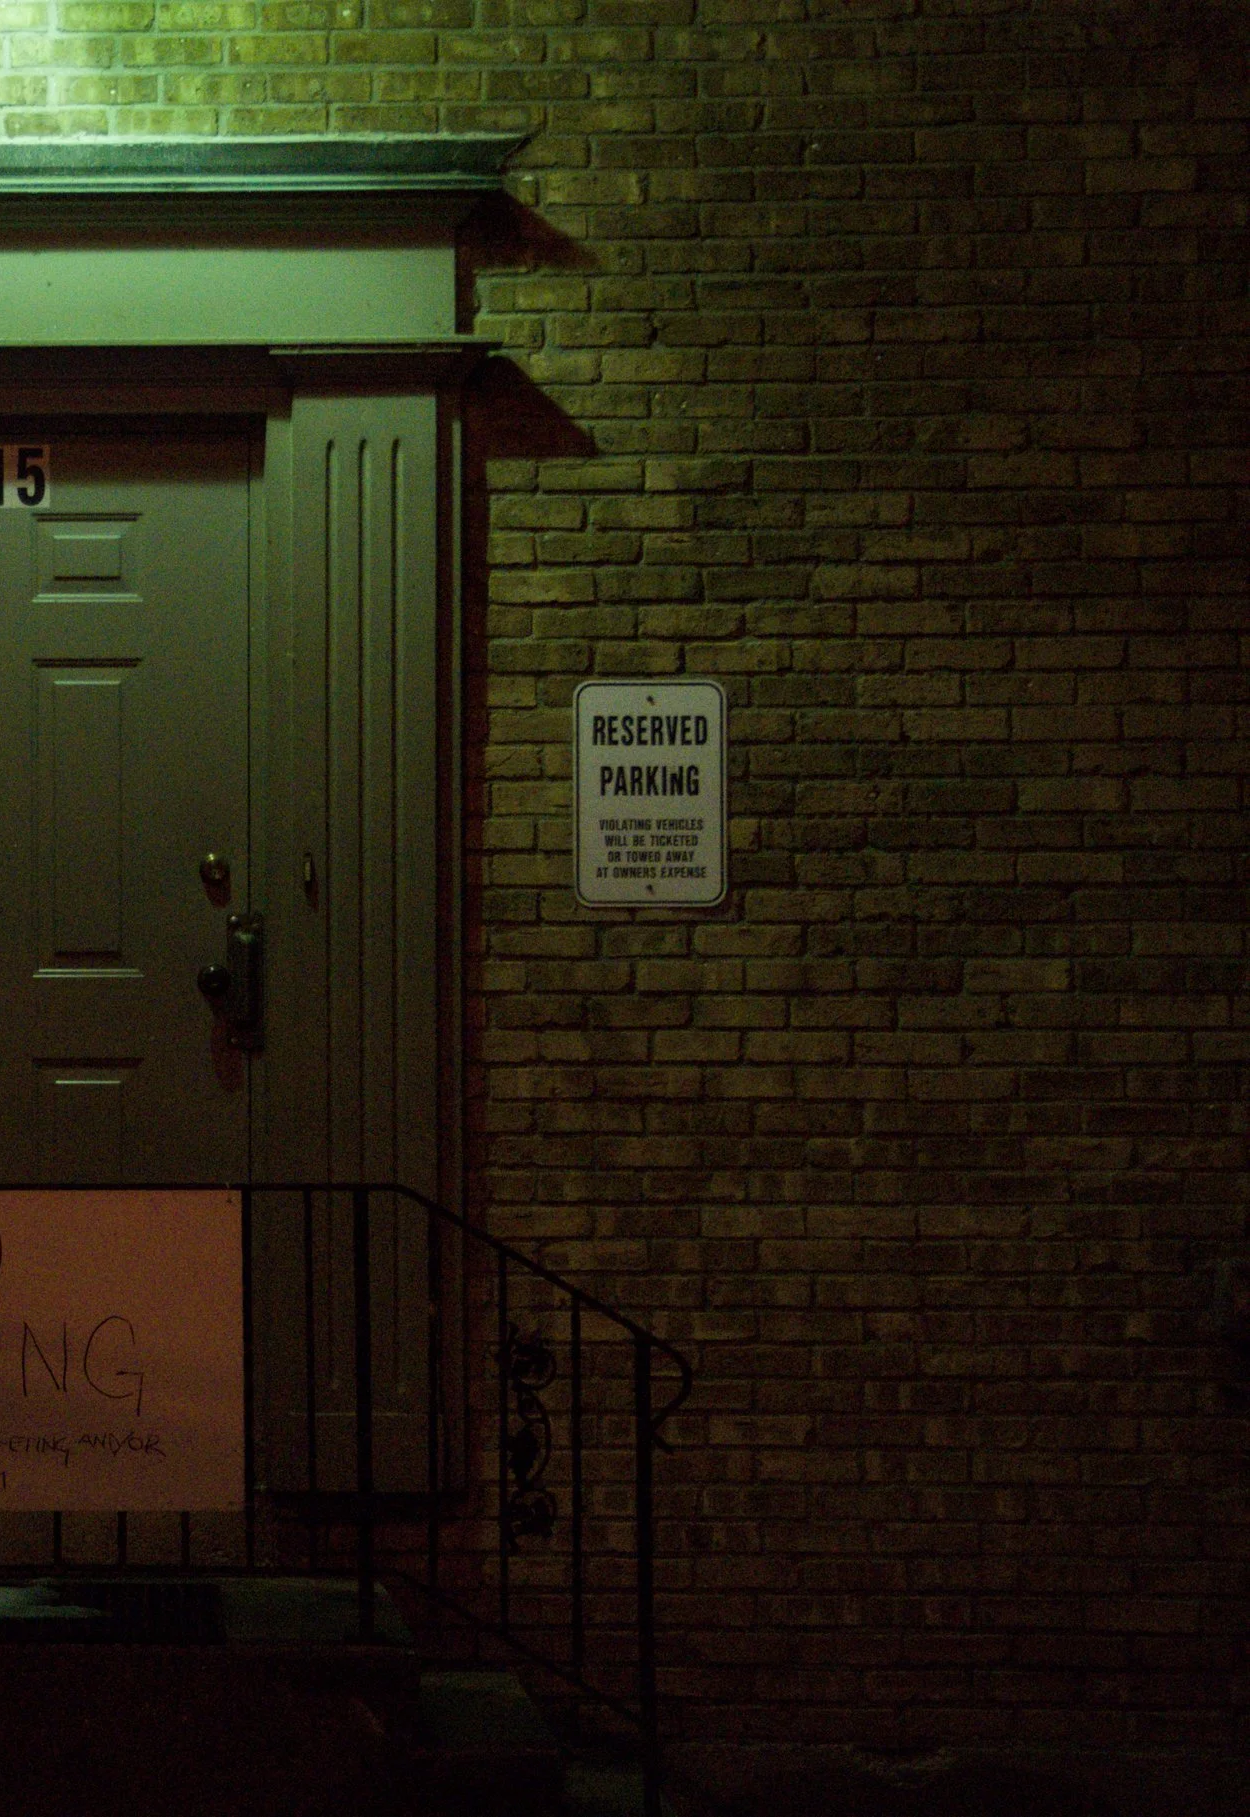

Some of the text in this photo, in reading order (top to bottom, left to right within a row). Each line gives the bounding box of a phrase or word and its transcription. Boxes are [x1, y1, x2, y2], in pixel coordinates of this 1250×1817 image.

[592, 715, 708, 746] RESERVED
[600, 766, 700, 796] PARKING
[599, 819, 704, 831] VIOLATING VEHICLES
[604, 835, 699, 847] WILL BE TICKETED
[608, 851, 694, 863] OR TOWED AWAY
[596, 867, 707, 879] AT OWNERS EXPENSE
